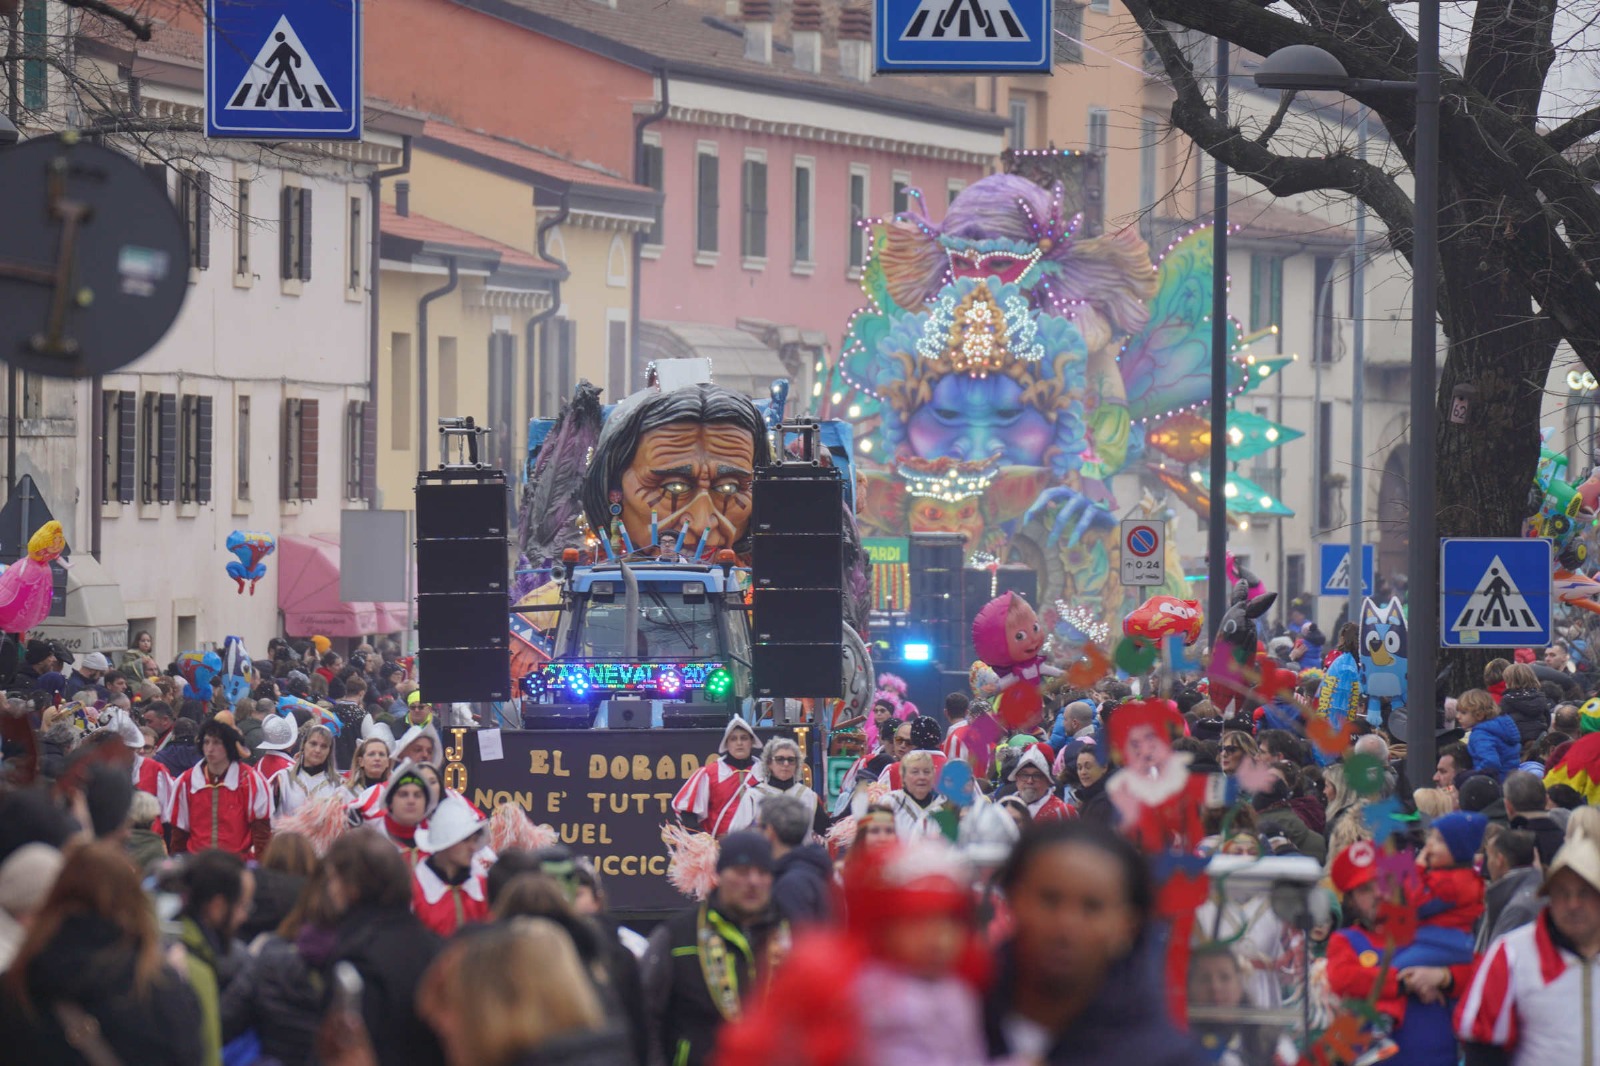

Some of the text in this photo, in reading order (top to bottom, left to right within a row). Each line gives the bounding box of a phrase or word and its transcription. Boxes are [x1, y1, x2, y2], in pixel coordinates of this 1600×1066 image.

[1453, 404, 1467, 419] 62
[529, 750, 720, 781] EL DORAD
[473, 787, 534, 815] NON
[586, 792, 674, 814] TUTT
[536, 822, 613, 844] UEL
